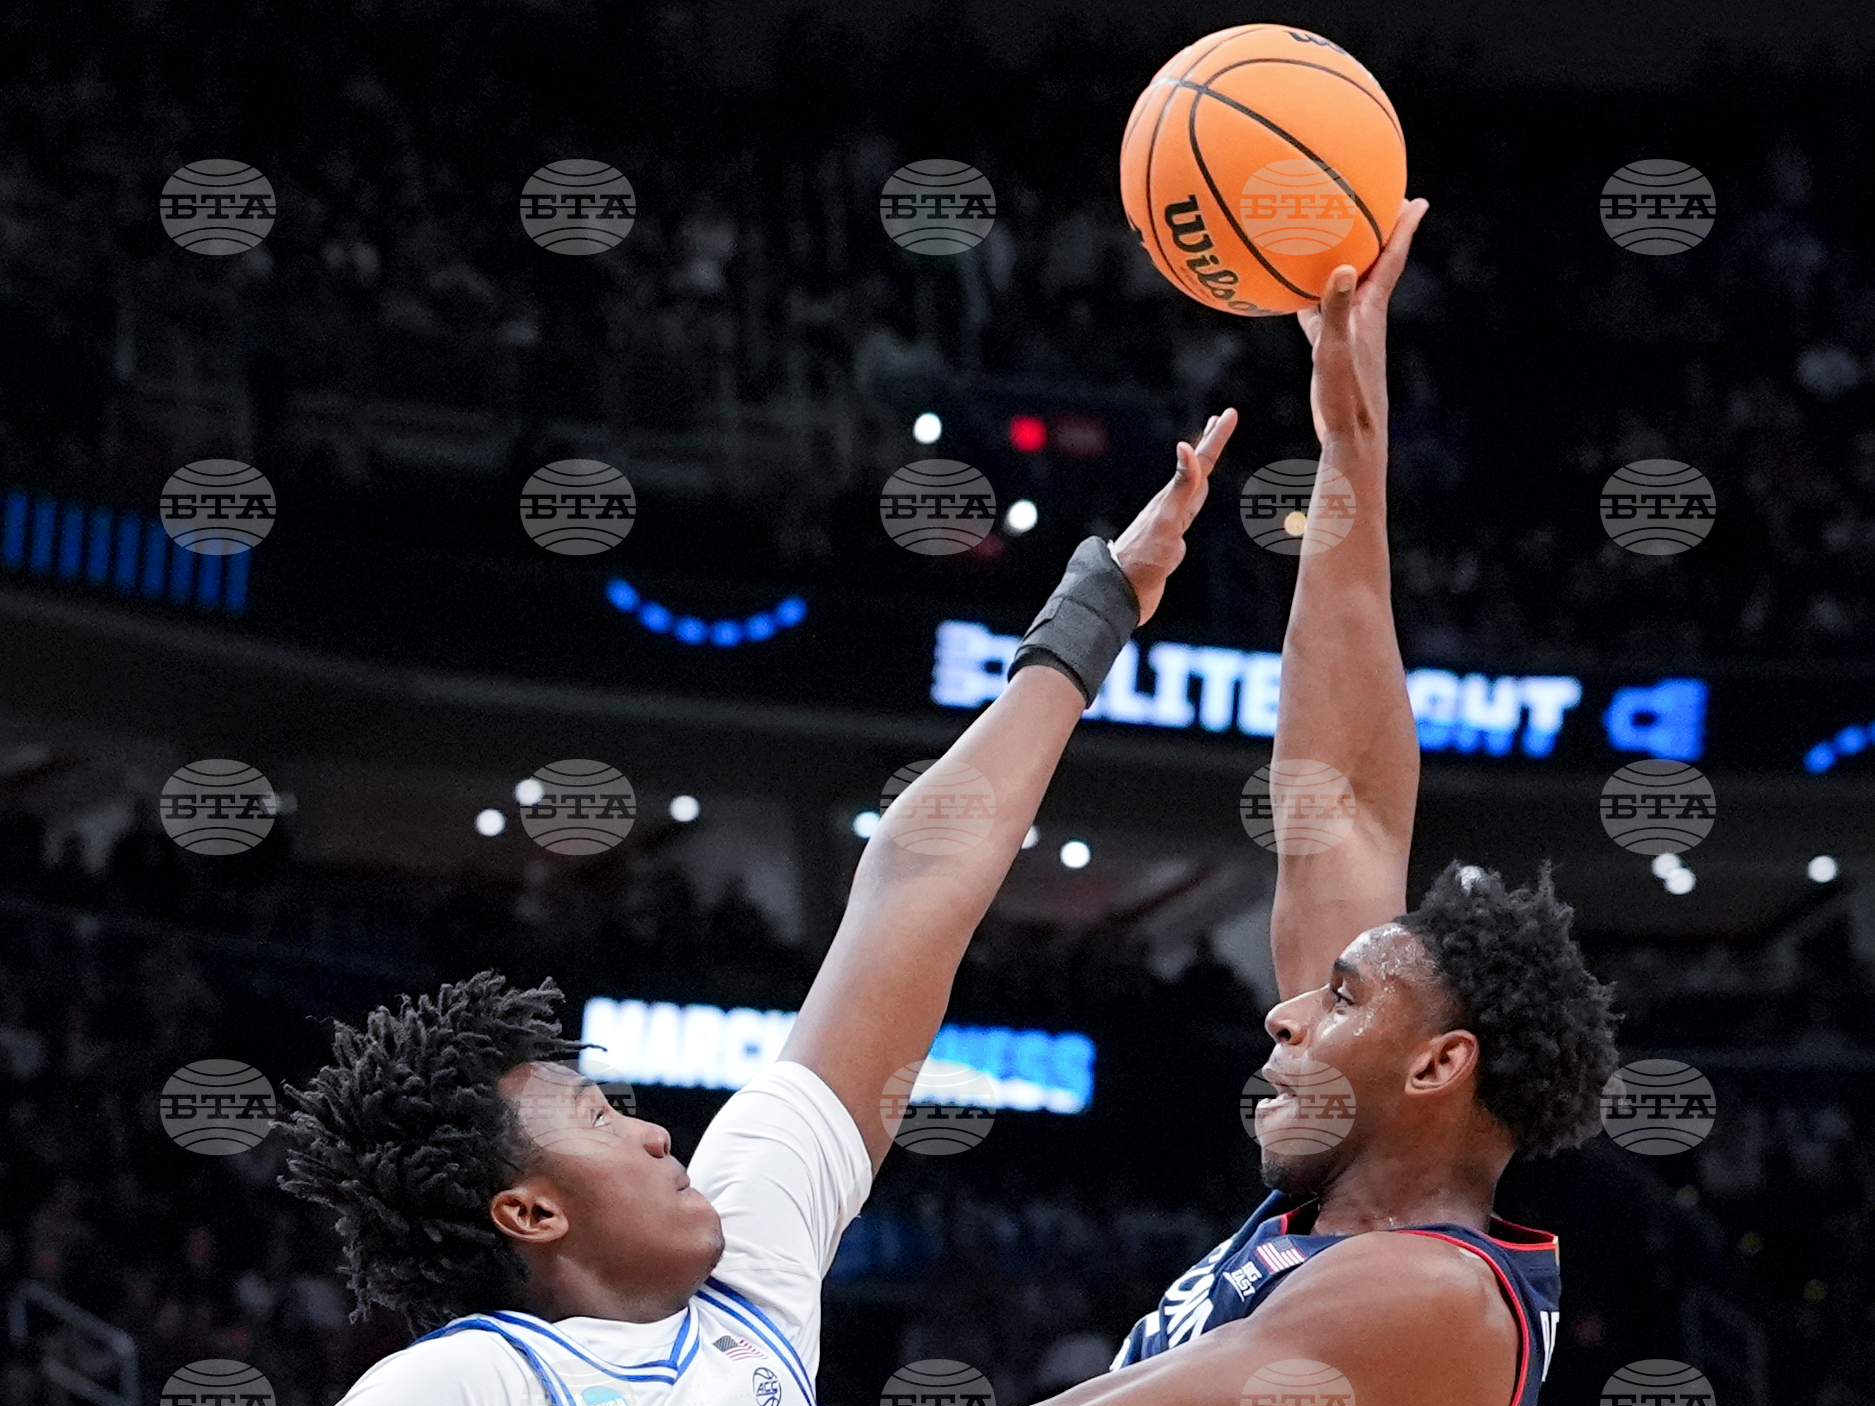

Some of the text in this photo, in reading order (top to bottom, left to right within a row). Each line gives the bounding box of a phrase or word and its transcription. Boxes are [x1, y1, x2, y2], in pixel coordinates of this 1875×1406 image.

[1081, 641, 1583, 758] LITE GHT
[1231, 1269, 1256, 1296] EAST
[1241, 1261, 1262, 1282] BIG
